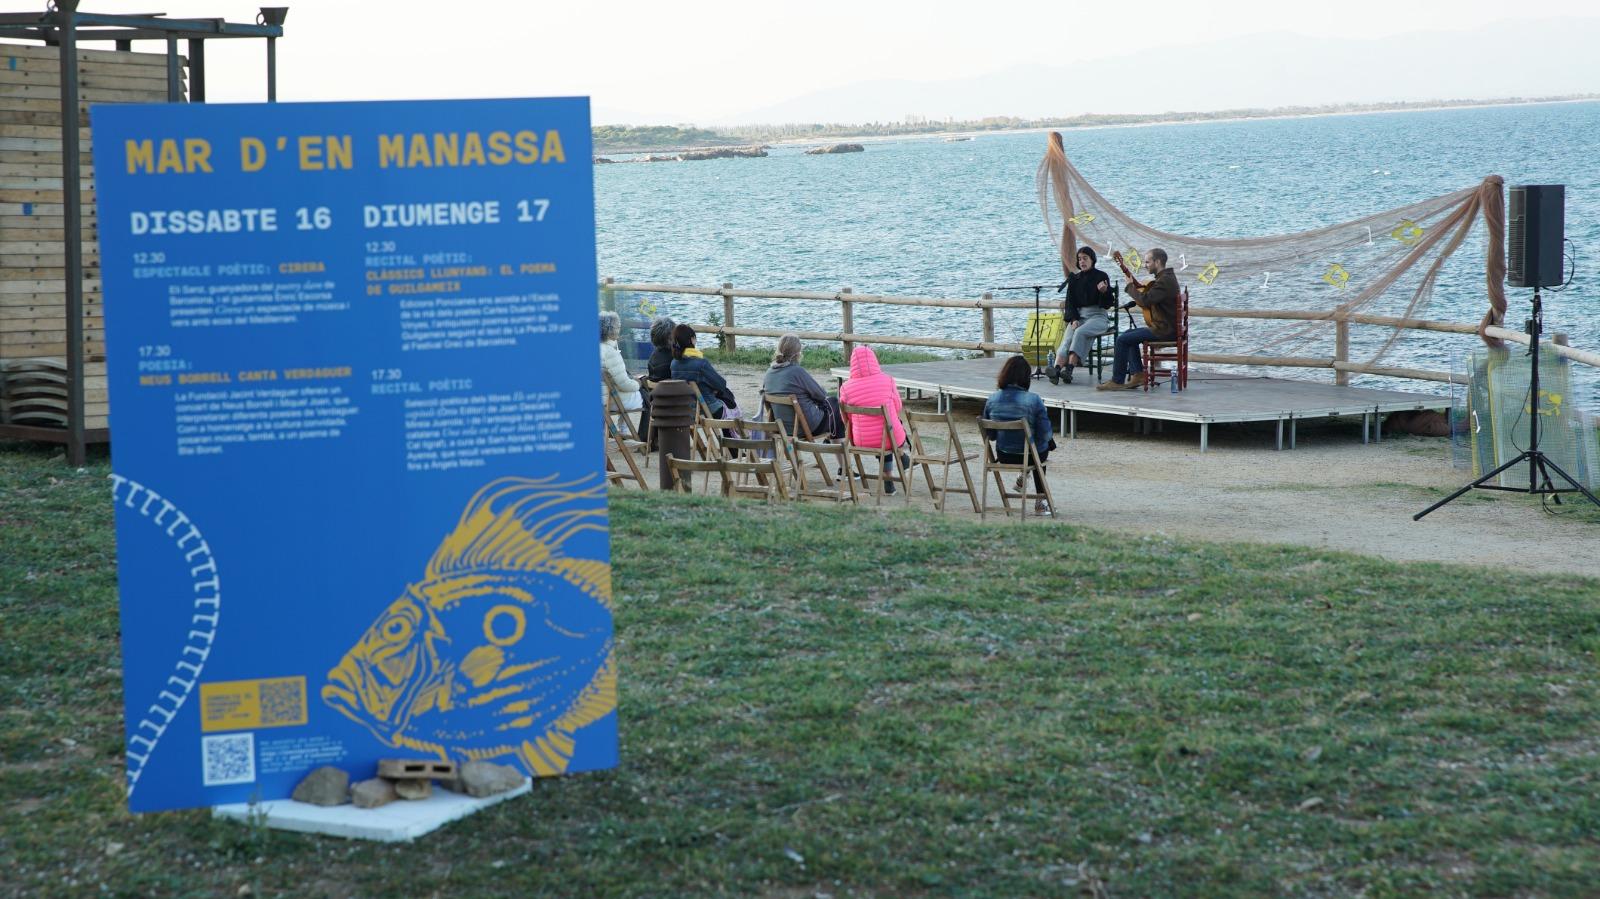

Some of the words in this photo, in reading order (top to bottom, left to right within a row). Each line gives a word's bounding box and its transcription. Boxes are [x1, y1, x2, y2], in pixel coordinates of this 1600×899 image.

[126, 138, 213, 175] MAR
[378, 129, 566, 169] MANASSA
[363, 202, 500, 229] DIUMENGE
[517, 200, 550, 223] 17
[131, 209, 278, 236] DISSABTE
[296, 208, 332, 231] 16
[366, 242, 396, 253] 12.30
[134, 252, 166, 264] 12.30
[365, 255, 416, 266] RECITAL
[133, 265, 211, 278] ESPECTACLE
[279, 262, 325, 273] CIRERA
[139, 346, 171, 357] 17.30
[139, 359, 192, 372] POESIA:
[139, 375, 172, 386] NEUS
[238, 370, 277, 382] CANTA
[372, 369, 402, 381] 17.30
[371, 382, 423, 394] RECITAL
[428, 378, 472, 391] POÈTIC
